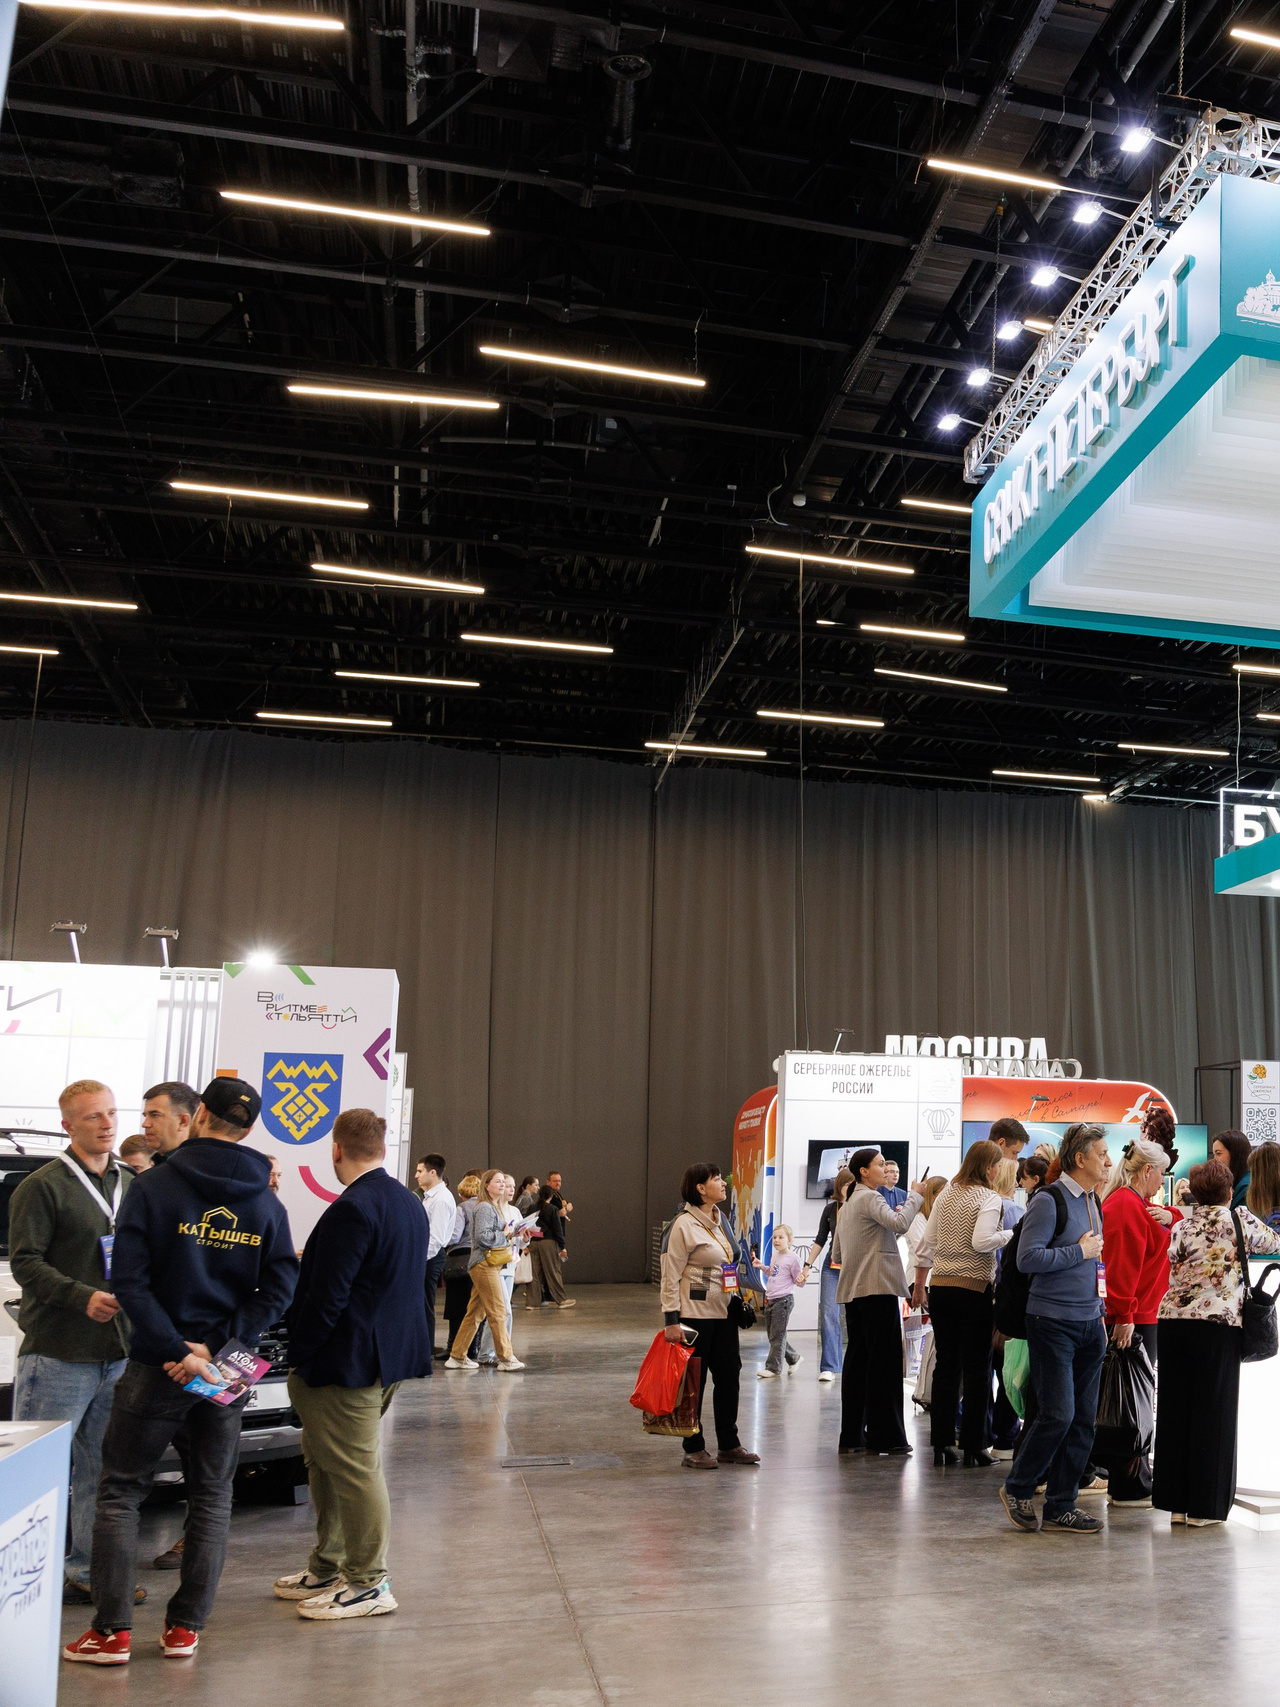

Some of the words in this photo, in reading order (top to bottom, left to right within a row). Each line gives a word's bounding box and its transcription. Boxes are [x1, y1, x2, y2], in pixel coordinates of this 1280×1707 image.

[0, 985, 62, 1013] И
[257, 991, 274, 1003] В
[265, 1003, 318, 1014] РИТМЕ
[793, 1062, 857, 1076] СЕРЕБРЯНОЕ
[859, 1064, 912, 1077] ОЖЕРЕЛЬЕ
[832, 1081, 874, 1094] РОССИИ
[178, 1222, 262, 1246] КАТЫШЕВ
[196, 1238, 235, 1250] СТРОИТ
